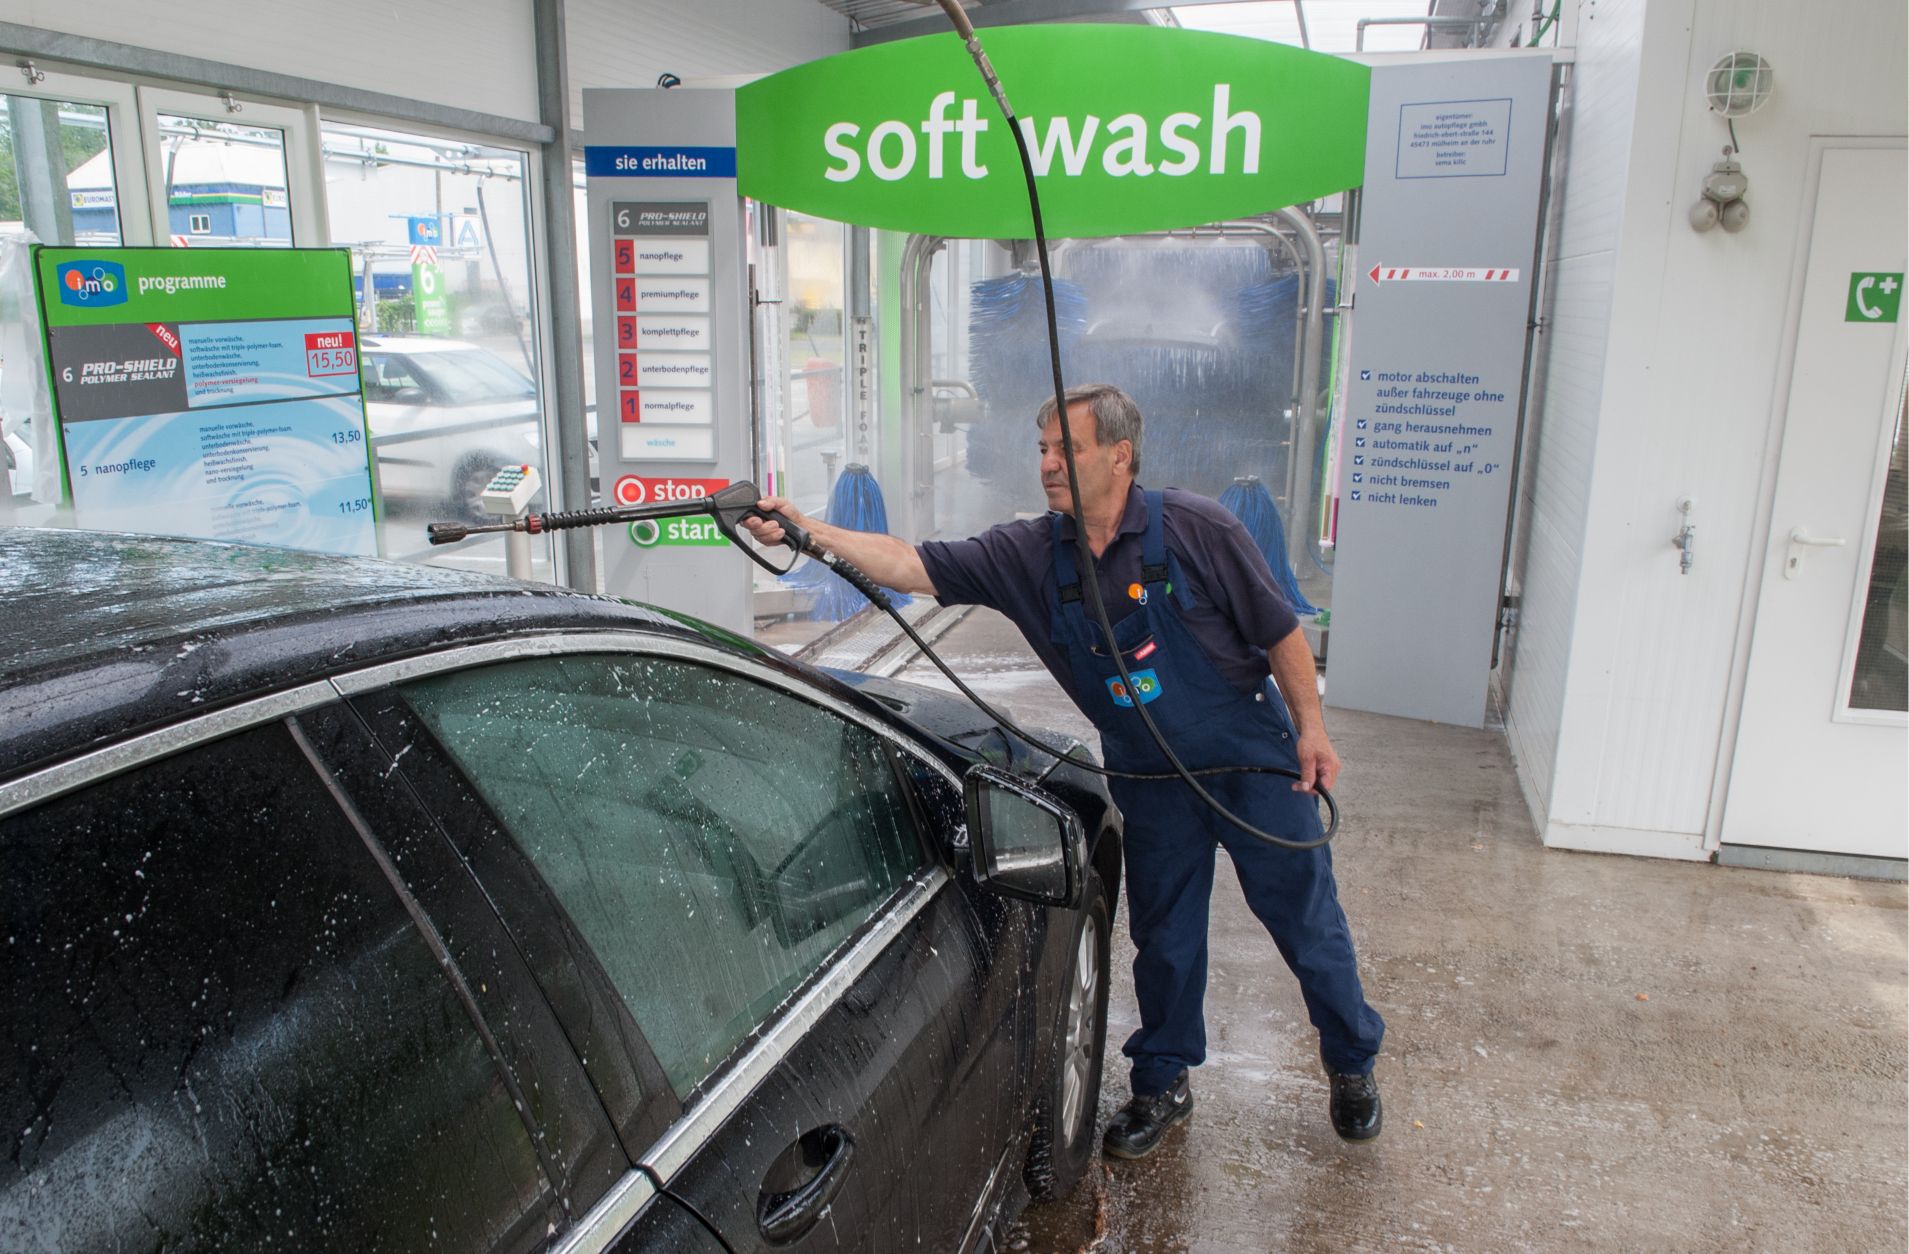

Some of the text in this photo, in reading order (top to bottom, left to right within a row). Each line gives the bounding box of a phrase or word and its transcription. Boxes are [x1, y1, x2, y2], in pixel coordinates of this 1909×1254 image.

[824, 83, 1262, 182] soft wash
[1433, 122, 1467, 130] autopflege
[1469, 121, 1488, 129] gmbh
[1413, 130, 1479, 139] friedrich-ebert-straße
[1470, 138, 1481, 146] der
[615, 153, 707, 170] sie erhalten
[617, 209, 706, 228] 6 PRO-SHIELD
[619, 247, 683, 265] 5 nanopflege
[138, 272, 227, 294] programme
[1418, 271, 1440, 279] max.
[1443, 270, 1464, 279] 2,00
[76, 277, 114, 293] imo
[620, 286, 699, 303] 4 premiumpflege
[155, 324, 178, 350] neu
[622, 323, 700, 341] 3 komplettpflege
[316, 333, 343, 349] neu!
[311, 350, 353, 370] 15,50
[857, 330, 869, 401] TRIPLE
[62, 357, 178, 383] 6 PRO-SHIELD
[80, 370, 175, 385] POLYMER SEALANT
[622, 361, 709, 378] 2 unterbodenpflege
[1378, 371, 1479, 385] motor abschalten
[1376, 386, 1505, 403] außer fahrzeuge ohne
[626, 398, 695, 416] 1 normalpflege
[1375, 403, 1456, 416] zündschlüssel
[1373, 421, 1492, 436] gang herausnehmen
[331, 430, 361, 446] 13,50
[646, 438, 676, 447] wäsche
[1372, 439, 1430, 452] automatik
[1433, 442, 1453, 453] auf
[80, 456, 156, 477] 5 nanopflege
[1370, 457, 1450, 471] zündschlüssel
[1453, 462, 1474, 473] auf
[654, 480, 706, 501] stop
[1369, 474, 1450, 490] nicht bremsen
[1368, 492, 1437, 507] nicht lenken
[668, 519, 722, 540] start
